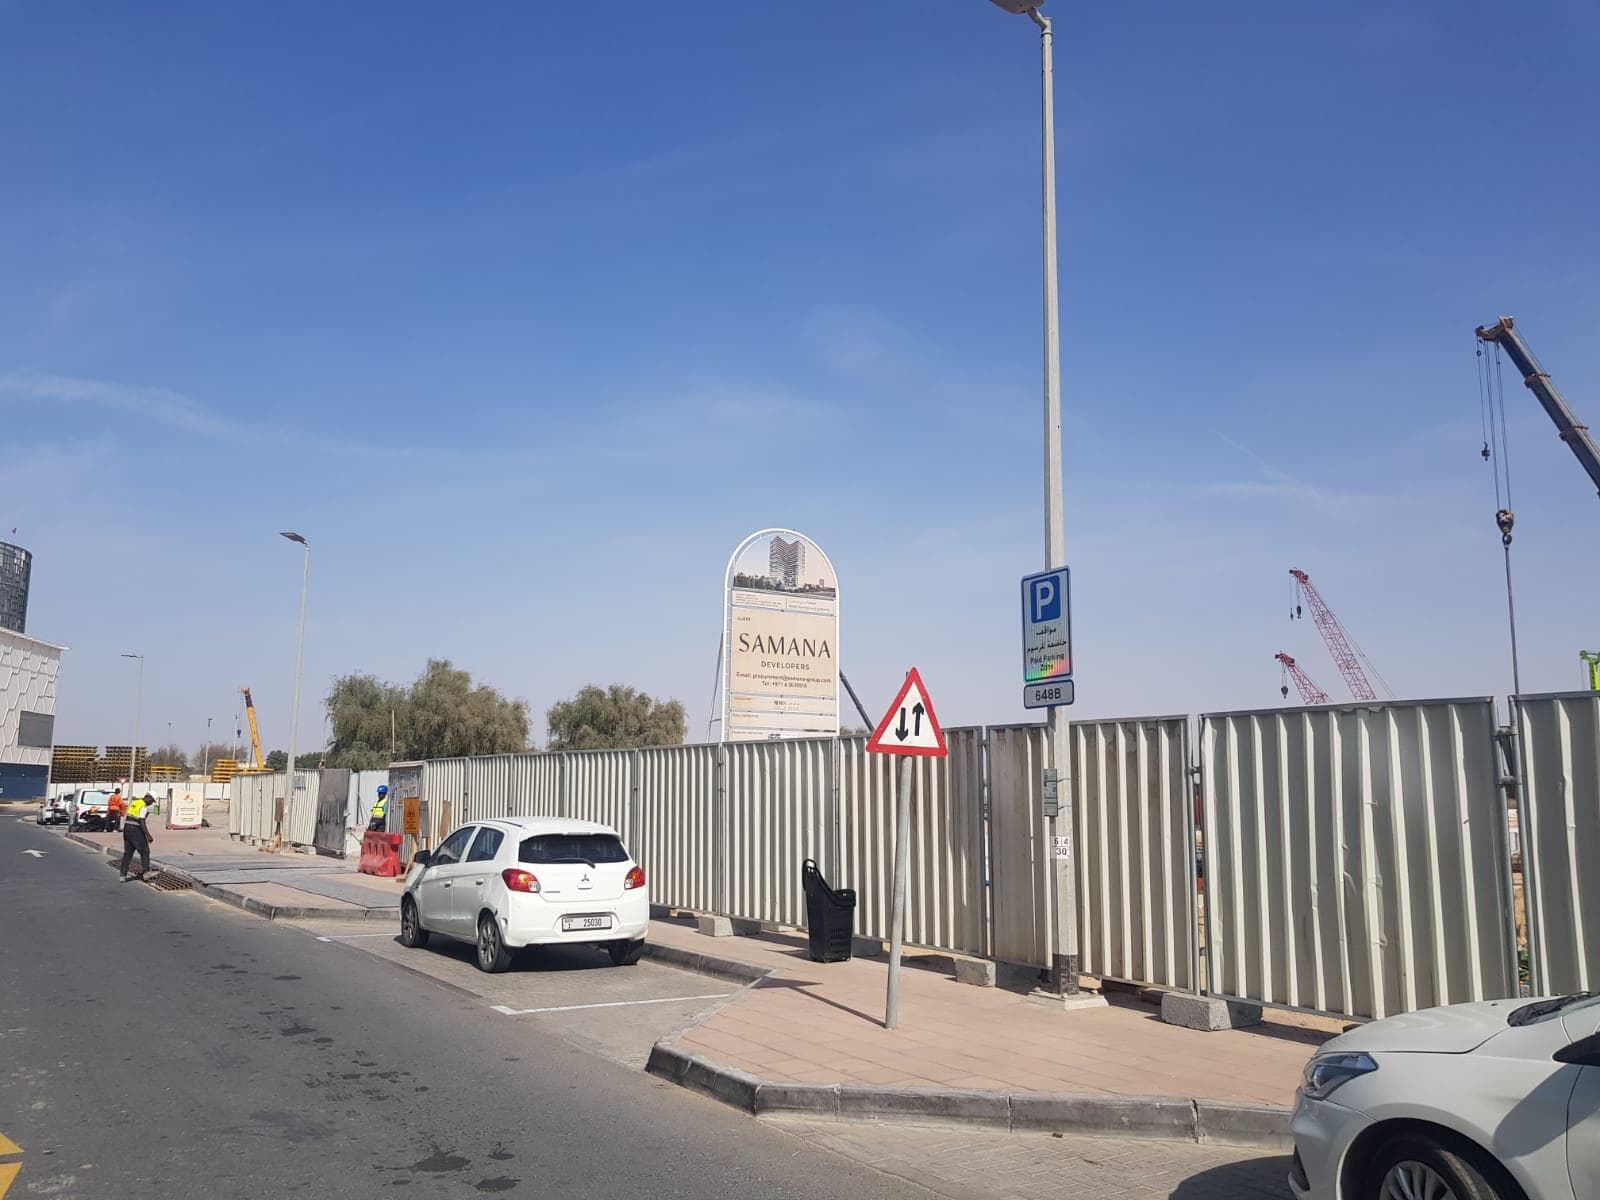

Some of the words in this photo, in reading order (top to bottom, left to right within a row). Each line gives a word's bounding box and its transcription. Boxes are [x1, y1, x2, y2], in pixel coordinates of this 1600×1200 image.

[1036, 581, 1054, 620] P
[738, 632, 831, 659] SAMANA
[760, 660, 810, 671] DEVELOPERS
[1030, 655, 1042, 665] Paid
[1043, 653, 1065, 663] Parking
[1035, 687, 1062, 702] 648B
[583, 918, 602, 928] 25030
